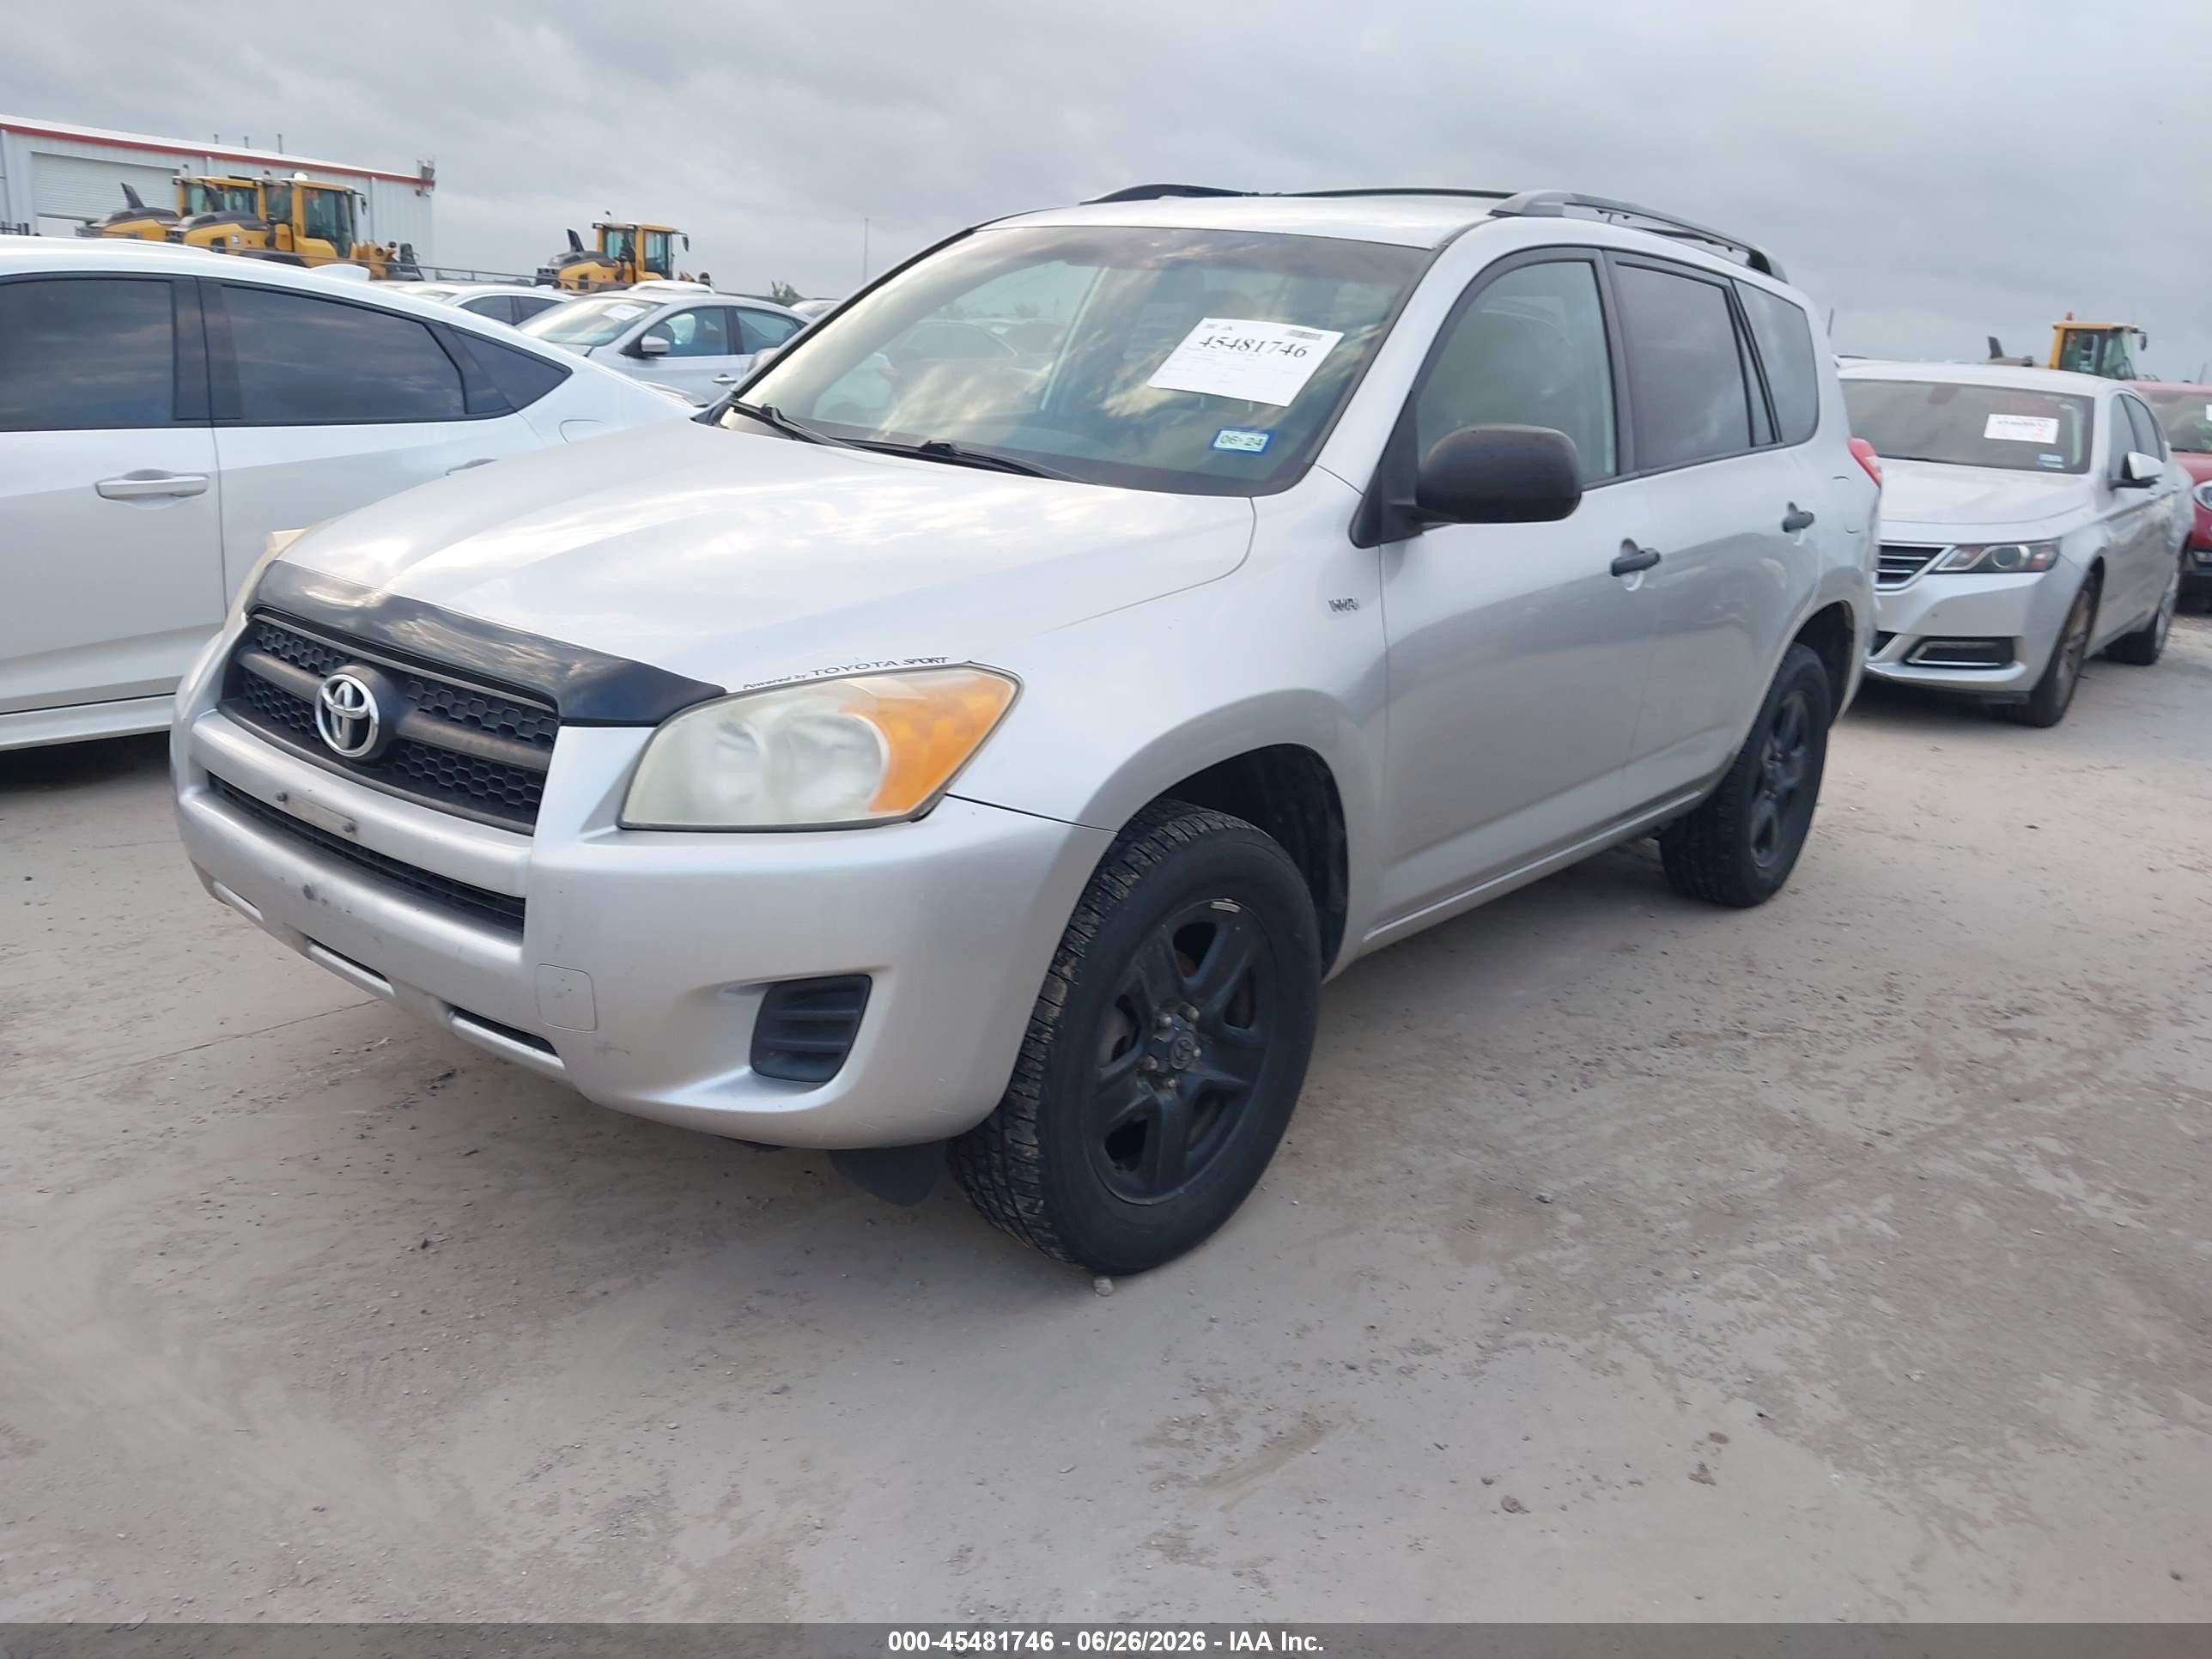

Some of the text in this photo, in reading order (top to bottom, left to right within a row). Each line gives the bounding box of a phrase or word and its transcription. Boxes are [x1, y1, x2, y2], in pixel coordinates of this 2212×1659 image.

[1199, 335, 1312, 358] 45481746
[811, 659, 898, 676] TOYOTA
[901, 656, 950, 665] SPORT
